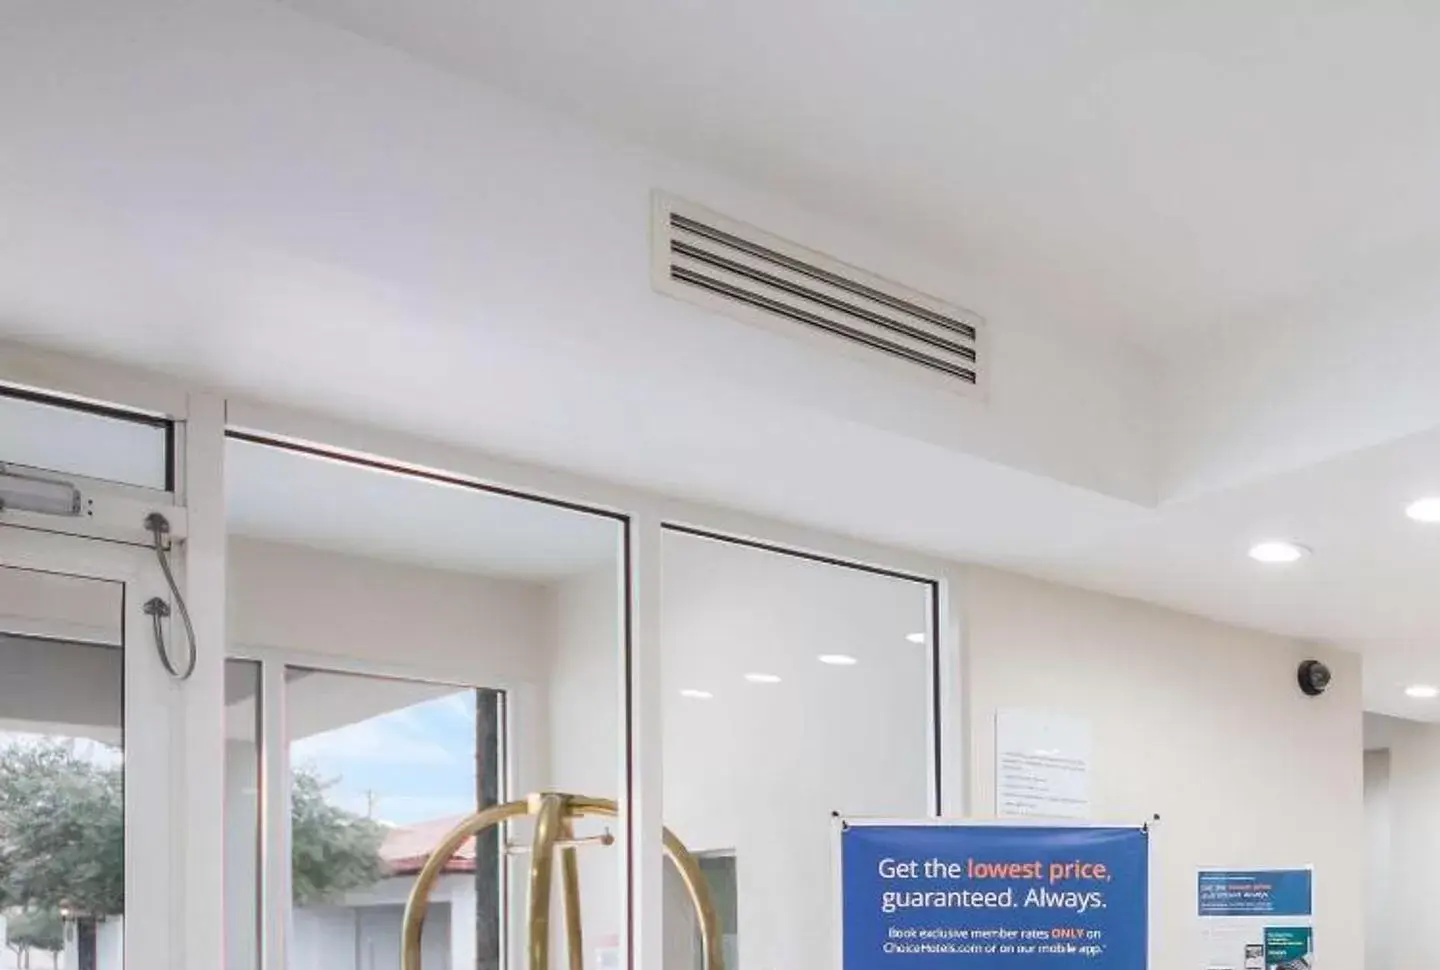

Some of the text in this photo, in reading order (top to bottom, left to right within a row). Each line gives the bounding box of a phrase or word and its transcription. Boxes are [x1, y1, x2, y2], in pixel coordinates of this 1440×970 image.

[879, 858, 1111, 883] Get the lowest price,
[882, 888, 1107, 912] guaranteed. Always.
[889, 927, 917, 938] Book
[920, 927, 968, 938] exclusive
[971, 927, 1018, 938] member
[1021, 929, 1049, 939] rates
[1051, 928, 1085, 938] ONLY
[883, 942, 983, 953] ChoiceHotels.com
[987, 945, 998, 953] or
[1000, 945, 1015, 953] on
[1017, 945, 1034, 953] our
[1038, 942, 1075, 953] mobile
